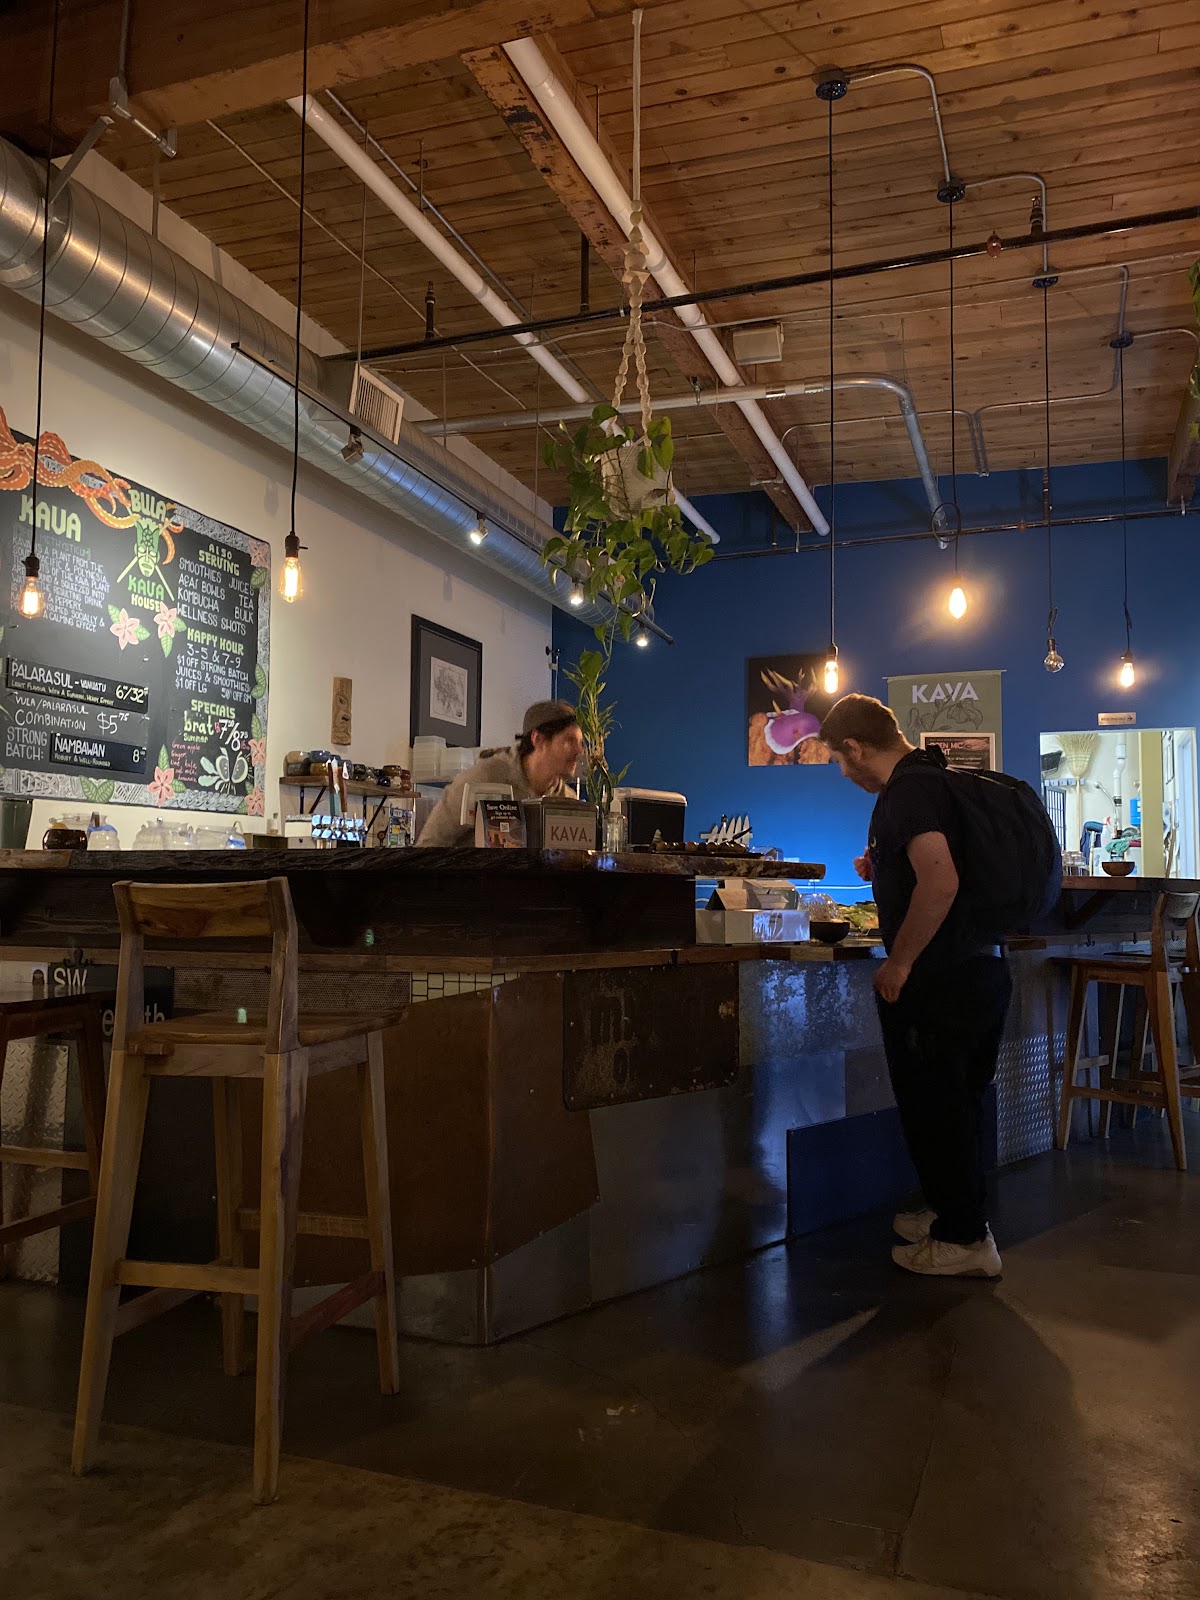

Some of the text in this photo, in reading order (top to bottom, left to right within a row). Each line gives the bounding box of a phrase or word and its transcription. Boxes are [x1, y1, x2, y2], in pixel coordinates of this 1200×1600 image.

[128, 489, 167, 523] BULA
[18, 494, 81, 542] KAVA
[12, 535, 104, 575] KAVA IS A PLANT FROM THE
[208, 543, 233, 560] ALSO
[65, 562, 71, 572] &
[179, 557, 222, 583] SMOOTHIES
[198, 549, 240, 577] SERVING
[12, 564, 26, 575] ARE
[54, 577, 59, 586] &
[61, 579, 90, 597] SQUEEZED
[91, 589, 104, 602] INTO
[52, 567, 58, 577] OF
[61, 570, 74, 582] THE
[74, 574, 90, 588] KAVA
[91, 579, 110, 594] PLANT
[128, 575, 165, 602] KAVA
[201, 581, 226, 600] BOWLS
[228, 577, 255, 596] JUICES
[48, 592, 54, 603] &
[53, 585, 82, 602] RESULTING
[84, 595, 103, 609] DRINK
[131, 593, 162, 613] HOUSE
[177, 587, 220, 613] KOMBUCHA
[239, 594, 255, 611] TEA
[43, 609, 49, 619] A
[49, 612, 74, 627] CALMING
[71, 609, 98, 625] SOCIALLY
[99, 617, 105, 628] &
[177, 602, 247, 636] WELLNESS SHOTS
[234, 606, 254, 624] BULK
[187, 627, 244, 656] HAPPY HOUR
[187, 642, 241, 669] 3-5 & 7-9
[11, 662, 74, 690] PALARASUL
[80, 679, 107, 693] VANUATU
[175, 665, 203, 681] JUICES
[204, 672, 211, 683] &
[176, 653, 249, 683] $1 OFF STRONG BATCH
[61, 688, 66, 696] A
[175, 676, 208, 694] $1 OFF LG
[911, 681, 980, 704] KAVA
[232, 691, 243, 702] OFF
[243, 693, 253, 705] SM
[190, 699, 236, 719] SPECIALS
[15, 709, 86, 731] COMBINATION
[183, 710, 215, 736] brat
[7, 726, 48, 746] STRONG
[183, 732, 209, 744] Summer
[5, 743, 44, 761] BATCH:
[55, 736, 106, 757] NAMBAWAN
[187, 743, 201, 755] apple
[486, 803, 518, 811] Save Online
[550, 825, 593, 843] KAVA.
[54, 967, 89, 988] SW
